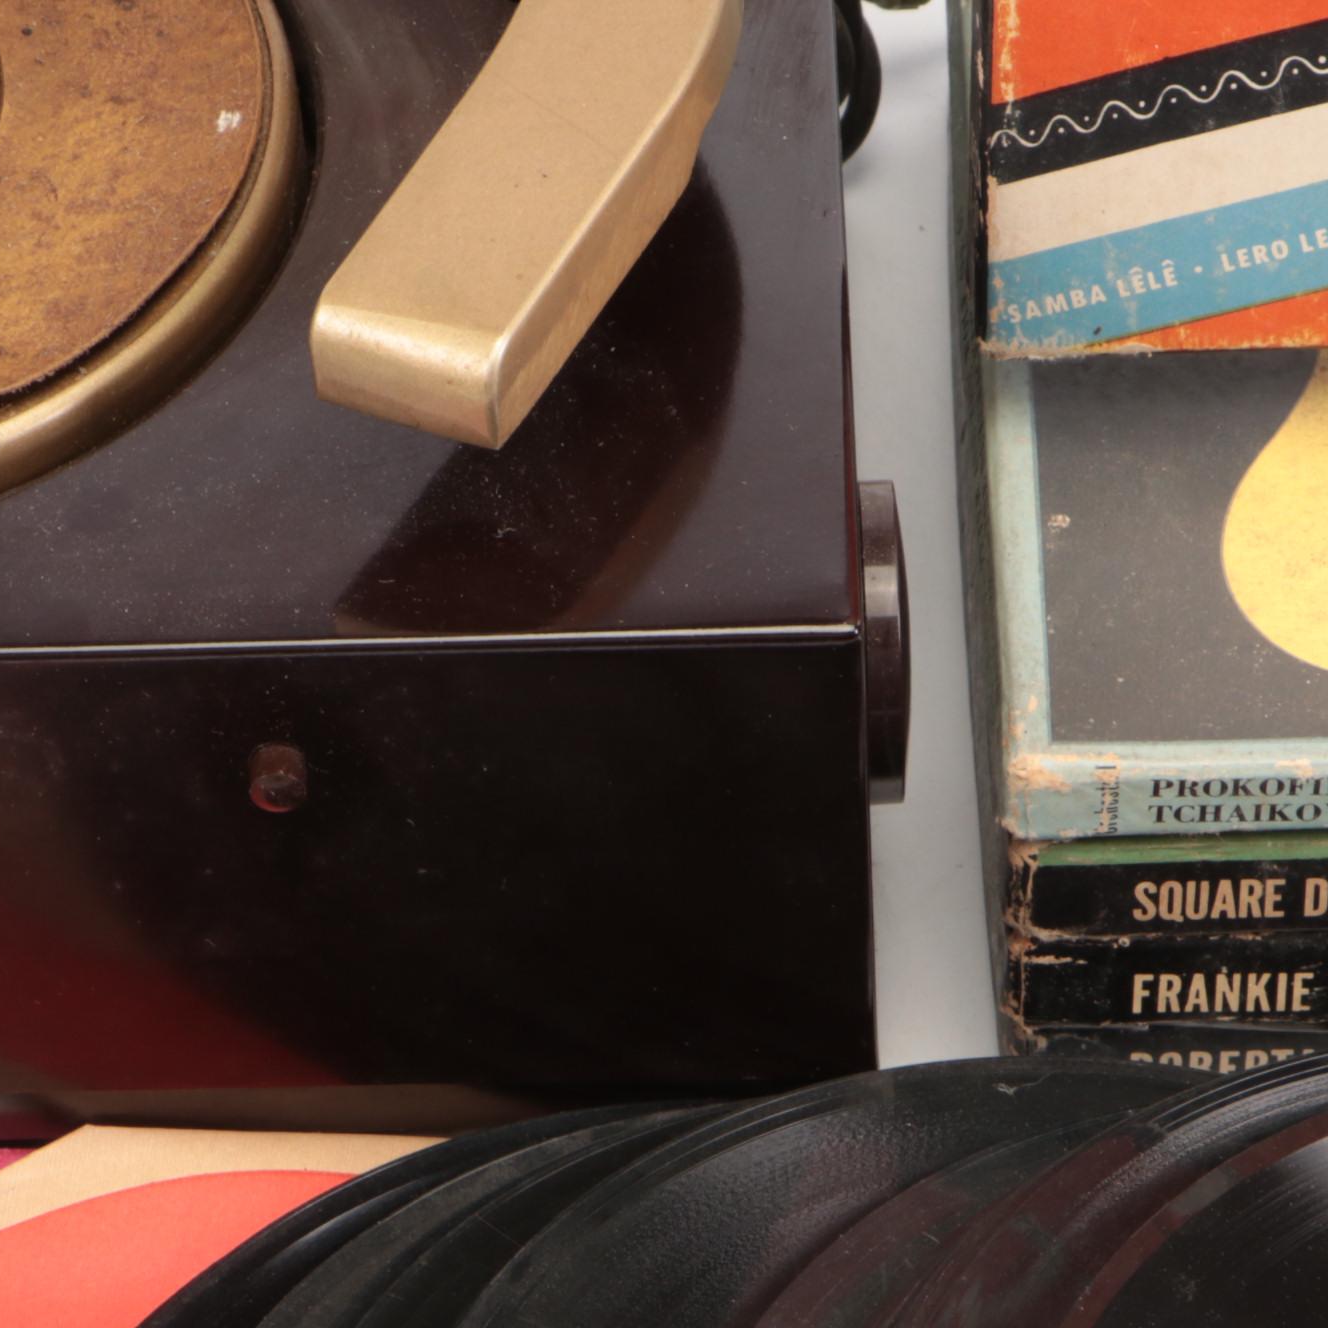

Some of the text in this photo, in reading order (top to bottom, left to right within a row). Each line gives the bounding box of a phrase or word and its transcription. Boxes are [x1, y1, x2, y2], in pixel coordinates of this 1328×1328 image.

[1007, 284, 1107, 324] SAMBA
[1115, 259, 1179, 299] LÊLÊ
[1220, 240, 1289, 273] LERO
[1132, 877, 1286, 922] SQUARE
[1131, 971, 1315, 1015] FRANKIE
